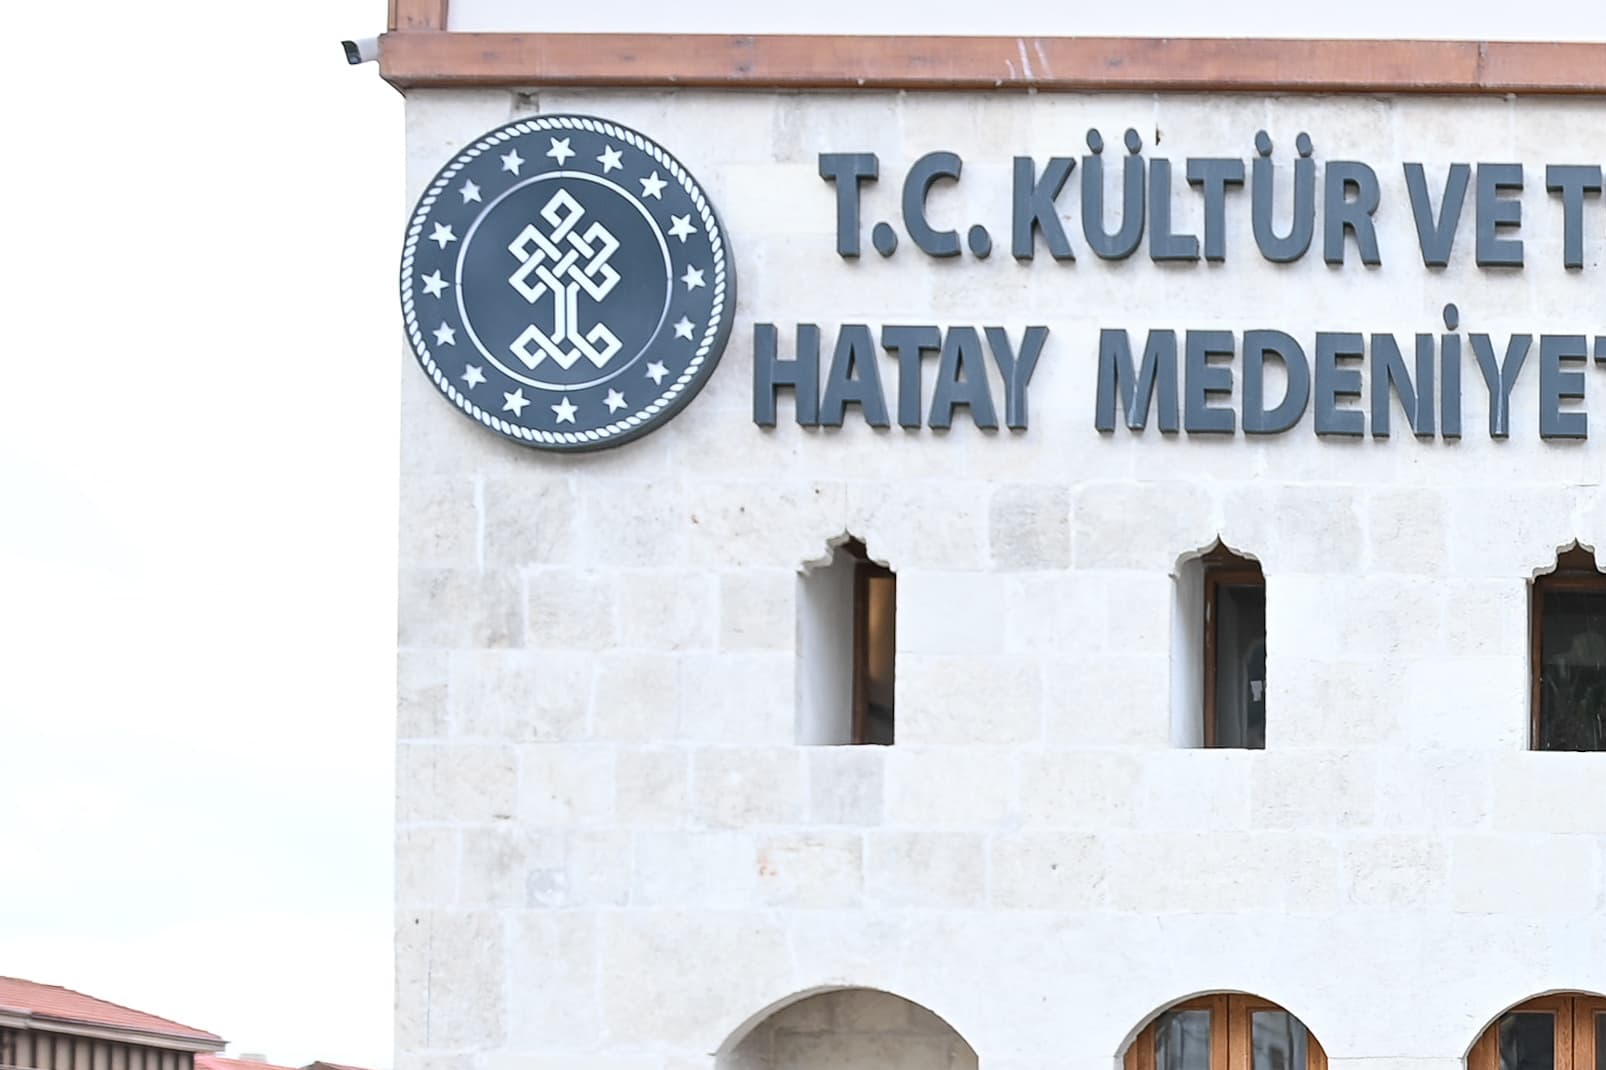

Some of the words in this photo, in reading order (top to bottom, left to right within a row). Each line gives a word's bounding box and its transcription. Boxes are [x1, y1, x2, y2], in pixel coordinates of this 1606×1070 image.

[819, 152, 992, 264] T.C.
[1012, 128, 1381, 266] KÜLTÜR
[1403, 162, 1525, 269] VE
[753, 323, 1050, 431] HATAY
